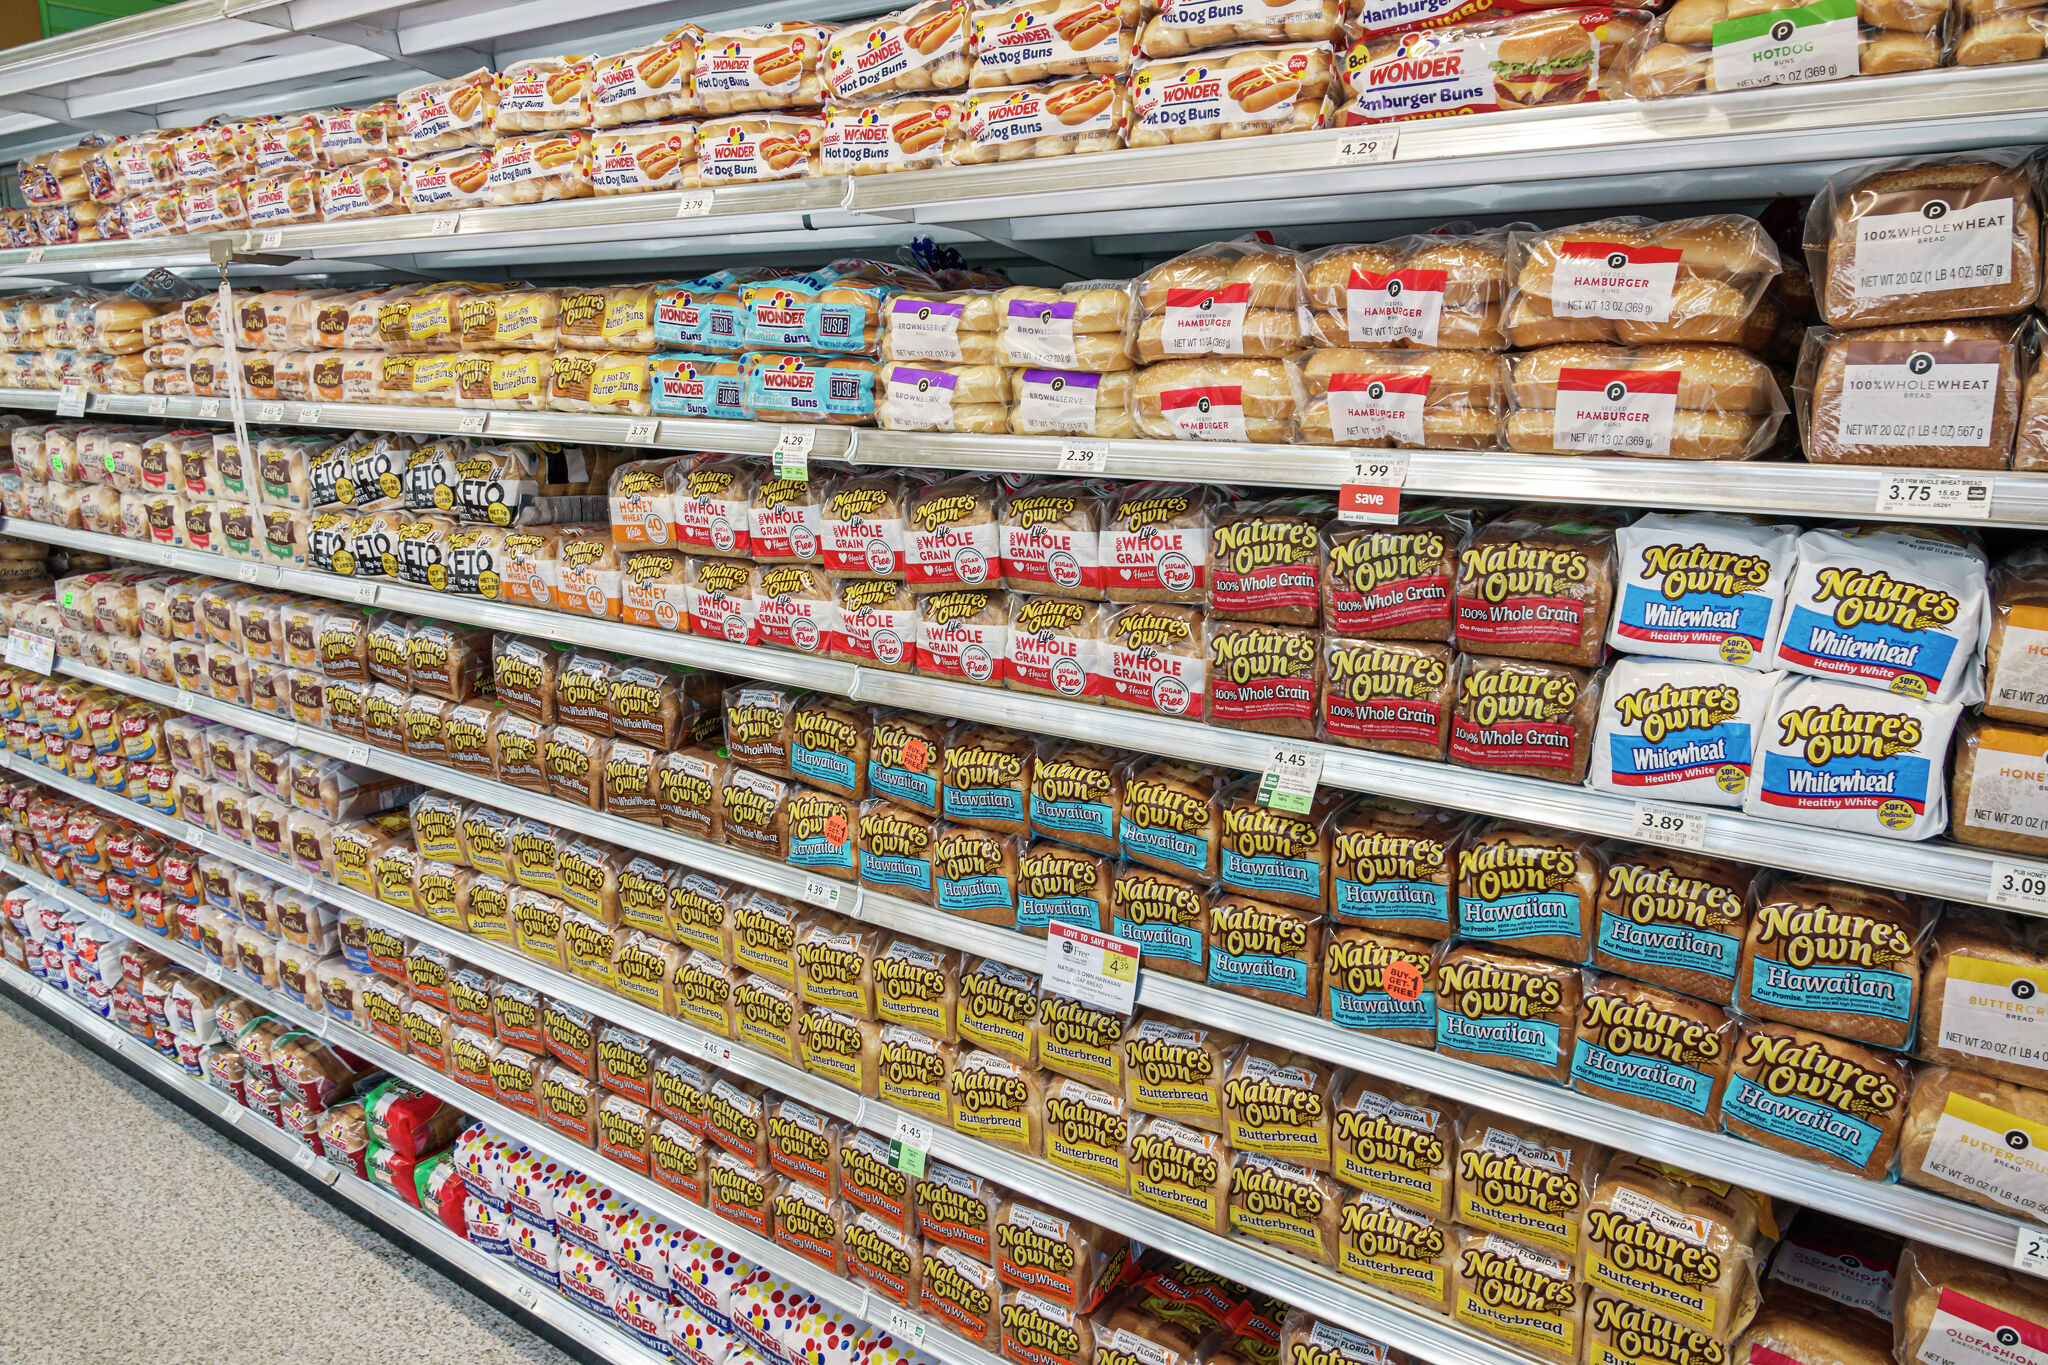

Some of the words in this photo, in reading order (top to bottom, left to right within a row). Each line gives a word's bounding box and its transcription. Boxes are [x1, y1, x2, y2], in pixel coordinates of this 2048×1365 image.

[832, 49, 842, 59] 8ct
[857, 40, 902, 68] WONDER
[1753, 41, 1814, 63] HOTDOG
[1349, 55, 1368, 68] 8ct
[1774, 57, 1795, 67] BUNS
[839, 76, 858, 94] Hot
[859, 69, 879, 86] Dog
[880, 59, 907, 77] Buns
[1370, 56, 1461, 86] WONDER
[514, 84, 543, 95] WONDER
[1164, 83, 1220, 103] WONDER
[1440, 87, 1483, 102] Buns
[1161, 111, 1187, 125] Dog
[1188, 107, 1220, 120] Buns
[1342, 141, 1377, 156] 4.29
[684, 200, 702, 210] 3.79
[1574, 277, 1649, 288] HAMBURGER
[1862, 276, 1877, 287] NET
[1879, 274, 1893, 285] WT
[1896, 273, 1907, 285] 20
[1909, 272, 1922, 284] OZ
[1924, 270, 1931, 285] (1
[1935, 269, 1947, 281] LB
[1950, 267, 1955, 279] 4
[1957, 266, 1973, 280] OZ)
[1976, 264, 1994, 276] 567
[1996, 265, 2003, 277] g
[1568, 300, 1583, 310] NET
[1585, 301, 1597, 311] WT
[1600, 301, 1611, 311] 13
[1613, 301, 1623, 312] OZ
[1625, 302, 1643, 313] (369
[1645, 303, 1653, 315] g)
[463, 313, 487, 328] Own
[498, 322, 519, 333] Butter
[520, 316, 538, 327] Buns
[827, 317, 843, 333] USO
[765, 374, 814, 389] WONDER
[792, 397, 818, 408] Buns
[1030, 393, 1084, 404] BROWN&SERVE
[1577, 410, 1649, 422] HAMBURGER
[632, 427, 648, 435] 3.79
[783, 436, 802, 446] 4.29
[1067, 450, 1093, 462] 2.39
[1354, 463, 1389, 477] 1.99
[834, 490, 887, 510] Nature's
[1355, 492, 1384, 505] save
[1889, 485, 1931, 500] 3.75
[842, 502, 873, 521] Own
[1118, 497, 1187, 521] Nature's
[1130, 510, 1166, 530] Own
[839, 525, 883, 537] WHOLE
[1140, 526, 1157, 541] Life
[836, 538, 863, 549] GRAIN
[1123, 534, 1183, 551] WHOLE
[1116, 553, 1154, 564] GRAIN
[1165, 562, 1186, 570] SUGAR
[1462, 546, 1587, 581] Nature's
[562, 570, 598, 585] HONEY
[1133, 569, 1155, 579] Heart
[1165, 571, 1190, 585] Free
[565, 584, 586, 593] WHEAT
[1485, 573, 1553, 602] Own
[589, 591, 602, 603] 40
[1460, 607, 1488, 620] 100%
[1490, 607, 1532, 623] Whole
[1534, 608, 1579, 624] Grain
[1727, 639, 1747, 648] SOFT
[1780, 706, 1921, 745] Nature's
[1809, 736, 1885, 764] Own
[1274, 752, 1306, 767] 4.45
[660, 769, 712, 798] Nature's
[1788, 770, 1895, 794] Whitewheat
[671, 786, 700, 805] Own
[950, 791, 1013, 807] Hawaiian
[1798, 797, 1839, 809] Healthy
[1842, 798, 1878, 809] White
[1642, 814, 1684, 831] 3.89
[1975, 809, 1991, 820] NET
[1995, 812, 2009, 823] WT
[2012, 815, 2023, 826] 20
[2026, 817, 2039, 829] OZ
[808, 884, 823, 896] 4.39
[2003, 875, 2045, 895] 3.09
[624, 906, 664, 923] Butterbread
[1759, 906, 1911, 954] Nature's
[1064, 929, 1078, 939] LOVE
[1091, 937, 1105, 947] SAVE
[1107, 942, 1123, 952] HERE.
[1789, 936, 1873, 967] Own
[1439, 963, 1559, 1004] Nature's
[1767, 967, 1895, 1000] Hawaiian
[1757, 988, 1771, 996] Our
[1772, 991, 1803, 1002] Promise.
[1462, 990, 1528, 1018] Own
[2006, 1013, 2034, 1022] BREAD
[1447, 1016, 1545, 1046] Hawaiian
[704, 1042, 718, 1055] 4.45
[1946, 1032, 1962, 1043] NET
[1965, 1035, 1979, 1047] WT
[1981, 1040, 1993, 1050] 20
[1995, 1043, 2007, 1053] OZ
[2020, 1047, 2031, 1058] LB
[2034, 1049, 2040, 1059] 4
[986, 1060, 1011, 1071] FLORIDA
[1269, 1070, 1303, 1082] FLORIDA
[959, 1111, 1022, 1129] Butterbread
[901, 1123, 921, 1138] 4.45
[773, 1151, 801, 1171] Honey
[799, 1160, 827, 1181] Wheat
[1650, 1211, 1695, 1233] FLORIDA
[1590, 1211, 1720, 1281] Nature's
[1612, 1243, 1686, 1285] Own
[1002, 1261, 1030, 1283] Honey
[1030, 1271, 1071, 1293] Wheat
[518, 1286, 532, 1300] 4.39
[672, 1264, 718, 1309] WONDER
[1596, 1262, 1704, 1311] Butterbread
[703, 1307, 728, 1328] WHITE
[892, 1315, 908, 1331] 4.11
[1925, 1351, 1940, 1361] NET
